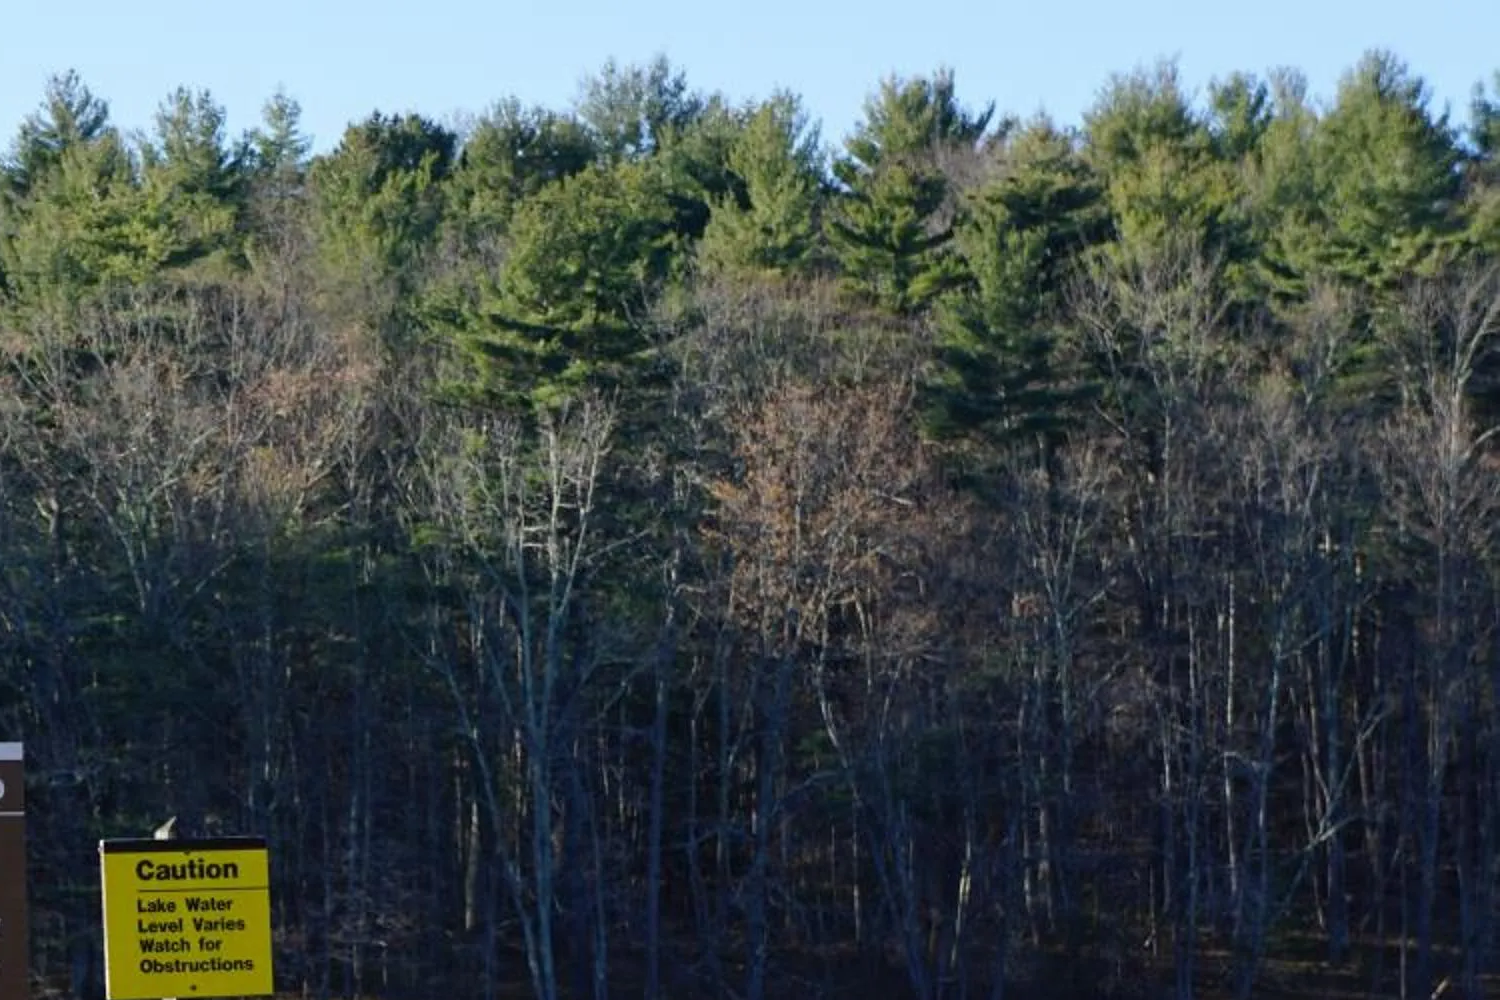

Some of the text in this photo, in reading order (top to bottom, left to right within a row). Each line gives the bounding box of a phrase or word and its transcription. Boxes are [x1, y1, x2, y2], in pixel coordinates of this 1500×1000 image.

[135, 858, 239, 881] Caution
[137, 898, 233, 913] Lake Water
[137, 918, 245, 933] Level Varies
[139, 937, 223, 953] Watch for
[140, 958, 254, 974] Obstructions
